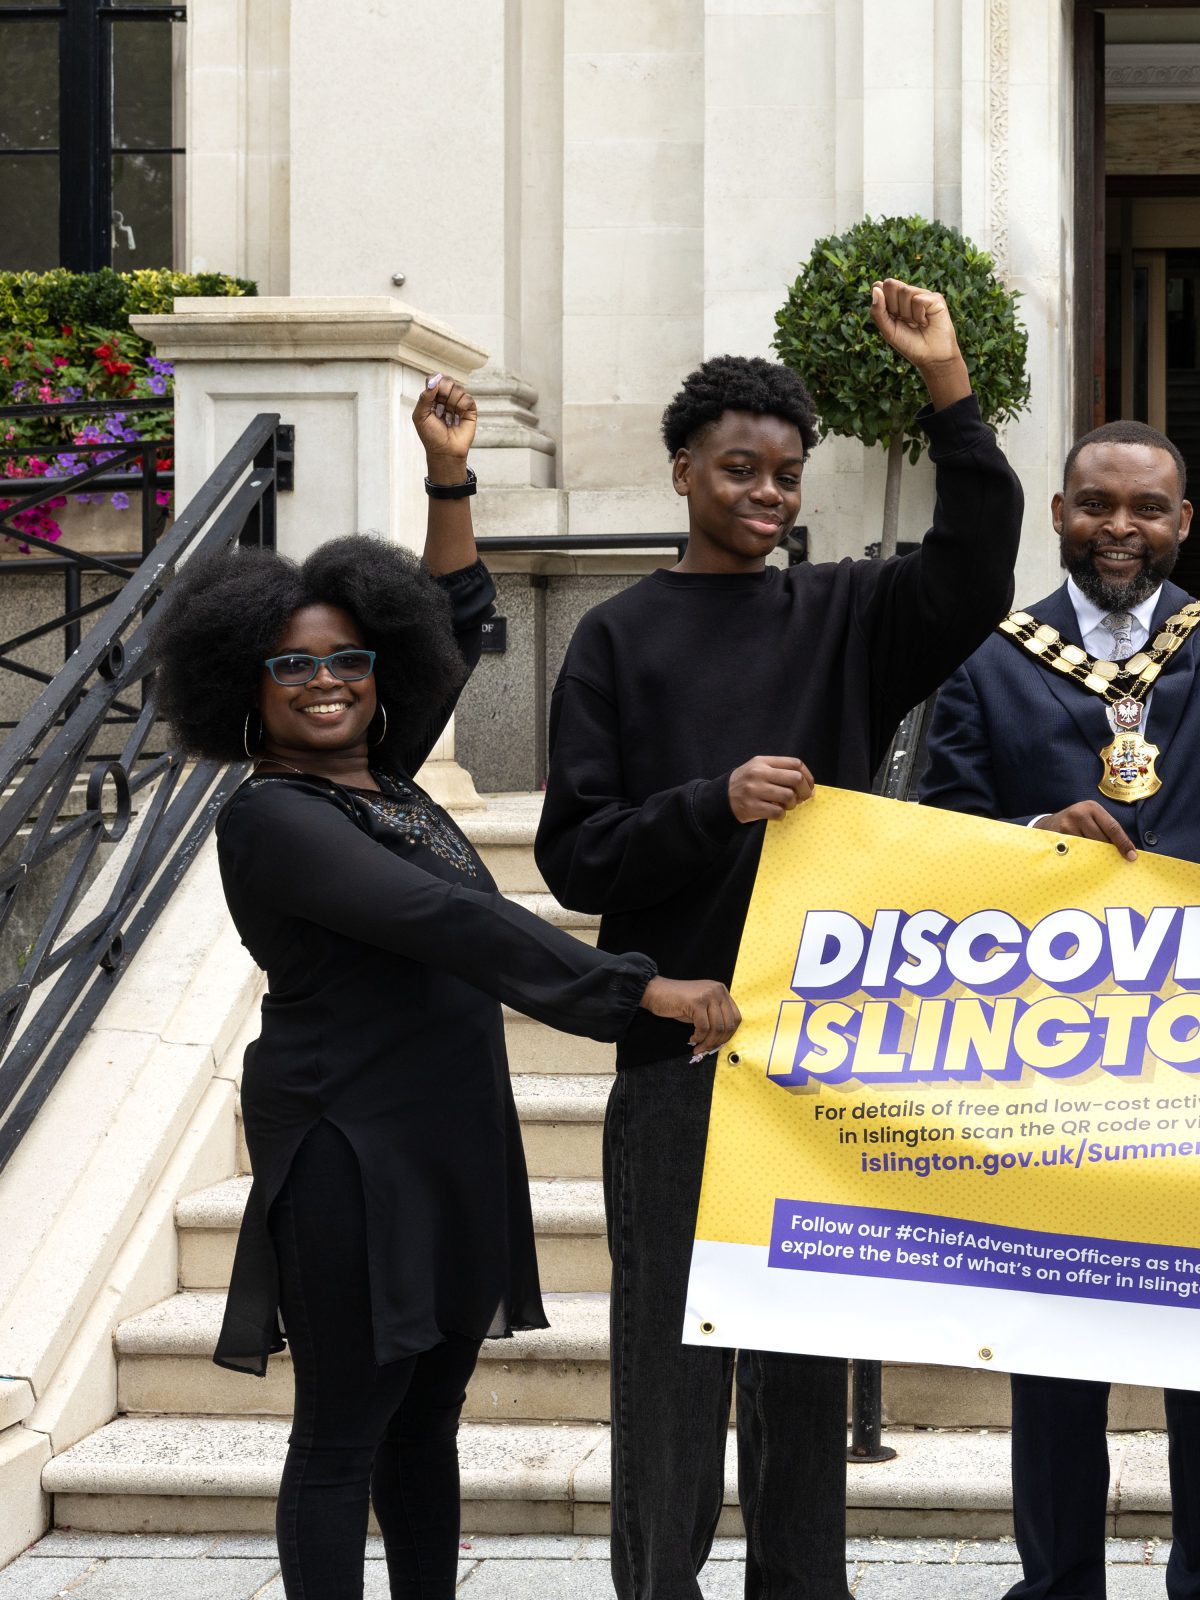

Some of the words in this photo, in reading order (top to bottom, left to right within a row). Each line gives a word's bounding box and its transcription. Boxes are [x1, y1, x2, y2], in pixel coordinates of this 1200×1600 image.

[814, 1105, 846, 1120] For
[851, 1100, 925, 1120] details
[931, 1100, 953, 1116] of
[958, 1100, 1000, 1116] free
[1005, 1099, 1048, 1115] and
[1054, 1096, 1151, 1113] low-cost
[839, 1127, 857, 1144] in
[863, 1125, 955, 1148] Islington
[961, 1126, 1014, 1140] scan
[1020, 1122, 1055, 1137] the
[1061, 1119, 1091, 1136] QR
[1097, 1117, 1151, 1133] code
[1157, 1118, 1179, 1130] or
[791, 1214, 854, 1235] Follow
[857, 1224, 891, 1239] our
[895, 1224, 1141, 1268] #ChiefAdventureOfficers
[1146, 1257, 1169, 1271] as
[781, 1239, 854, 1259] explore
[859, 1244, 891, 1262] the
[896, 1247, 939, 1267] best
[943, 1253, 963, 1269] of
[967, 1257, 1031, 1277] what’s
[1036, 1267, 1061, 1281] on
[1065, 1268, 1112, 1286] offer
[1116, 1272, 1134, 1288] in
